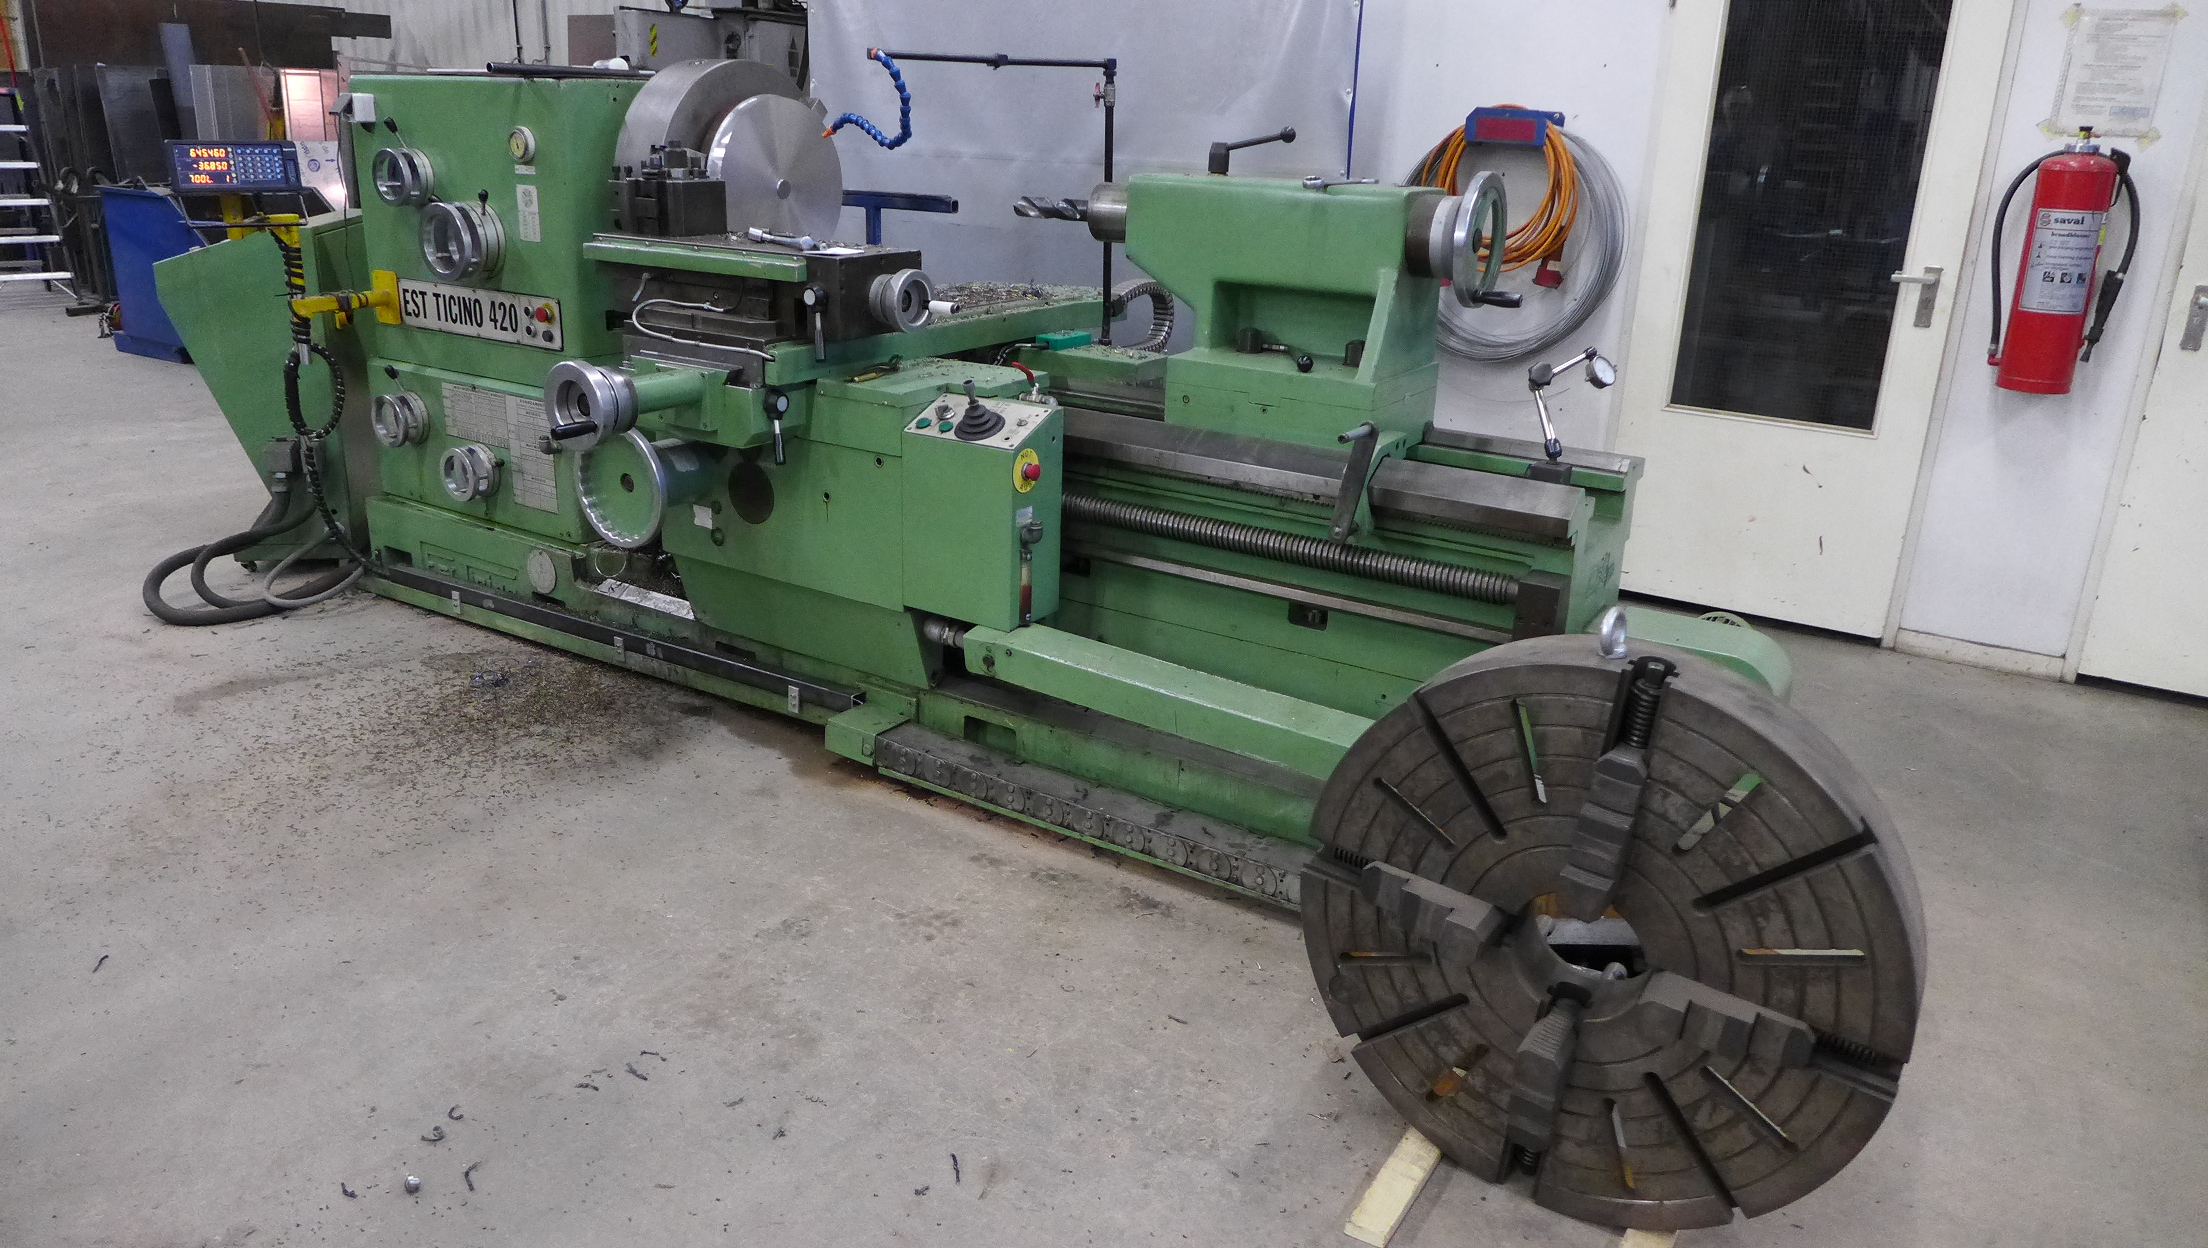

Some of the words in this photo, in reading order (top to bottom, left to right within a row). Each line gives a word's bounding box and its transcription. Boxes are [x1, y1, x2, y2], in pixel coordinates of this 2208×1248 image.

[2054, 216, 2085, 225] saval
[402, 288, 428, 319] EST
[432, 292, 484, 328] TICINO
[489, 300, 518, 333] 420
